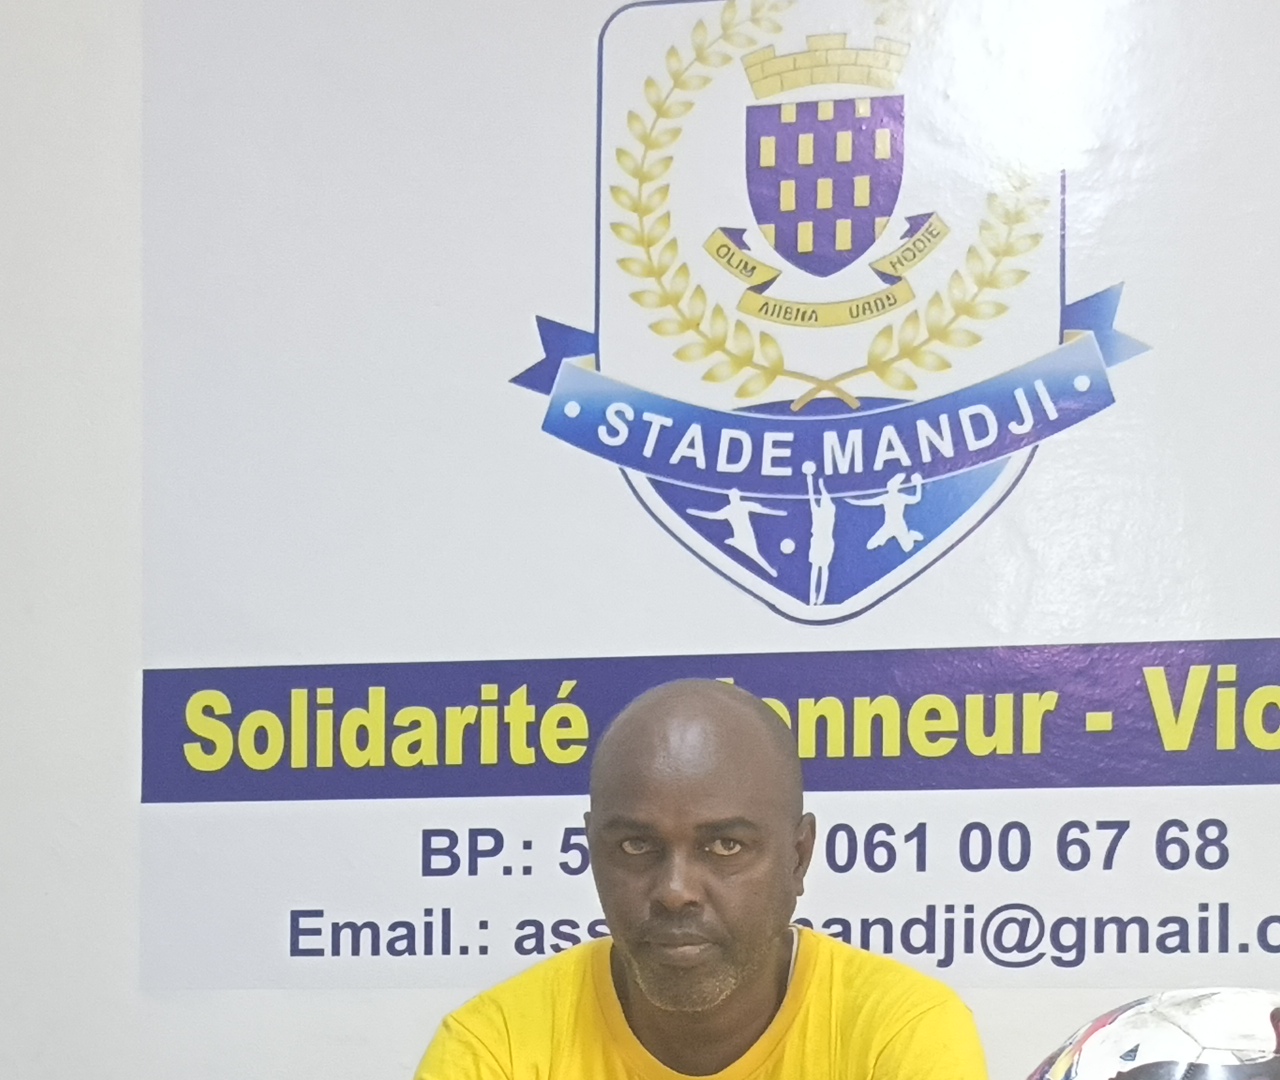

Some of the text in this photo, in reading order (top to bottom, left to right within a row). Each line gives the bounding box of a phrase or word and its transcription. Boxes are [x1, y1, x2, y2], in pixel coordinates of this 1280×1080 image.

[716, 244, 757, 278] OLIM
[889, 222, 940, 274] HODIE
[597, 380, 1059, 476] STADE MANDJI
[183, 680, 589, 771] Solidarité
[716, 677, 1058, 759] nneur
[421, 827, 532, 877] BP.:
[825, 822, 927, 874] 061
[959, 820, 1031, 873] 00
[1056, 820, 1130, 872] 67
[1155, 818, 1230, 871] 68
[290, 908, 489, 957] Email.:
